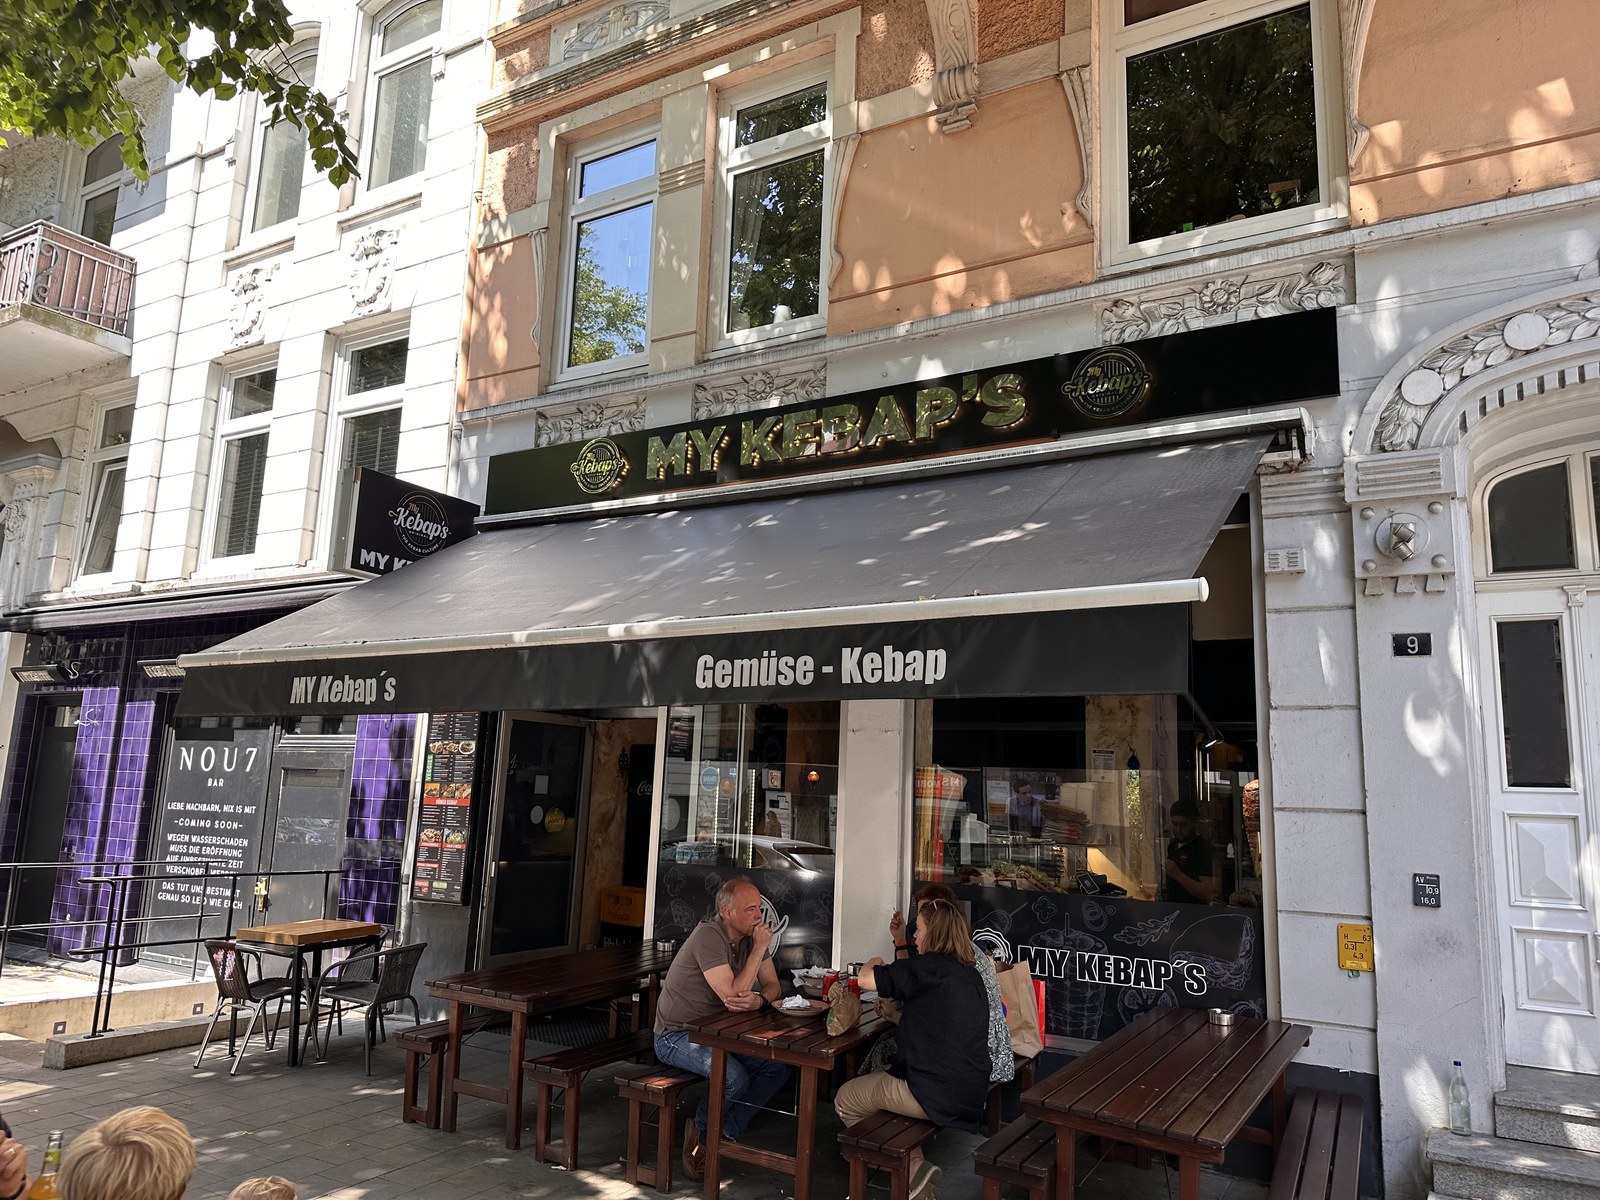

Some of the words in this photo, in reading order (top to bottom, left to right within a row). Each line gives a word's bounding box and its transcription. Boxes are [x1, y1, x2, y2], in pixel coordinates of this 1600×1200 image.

[646, 424, 729, 480] MY
[740, 373, 1027, 466] KEBAP'S
[393, 507, 449, 540] Kebap's
[422, 543, 439, 554] CULTURE
[359, 548, 390, 570] MY
[1406, 636, 1419, 654] 9
[695, 650, 815, 689] Gemüse
[841, 645, 947, 685] Kebap
[289, 675, 317, 704] MY
[179, 746, 258, 772] NOU7
[207, 778, 224, 787] BAR
[167, 802, 185, 810] LIEBE
[186, 803, 221, 813] NACHBARN,
[223, 804, 235, 812] NIX
[235, 805, 242, 813] IS
[244, 806, 256, 814] MIT
[167, 833, 190, 842] WEGEN
[191, 834, 248, 847] WASSERSCHADEN
[169, 844, 187, 852] MUSS
[188, 845, 199, 854] DIE
[201, 846, 242, 857] ERÖFFNUNG
[228, 859, 244, 869] ZEIT
[162, 881, 175, 890] DAS
[177, 883, 189, 892] TUT
[206, 886, 241, 898] BESTIMT
[157, 891, 179, 902] GENAU
[180, 894, 190, 903] SO
[192, 895, 207, 905] LED
[209, 897, 222, 907] WIE
[1362, 934, 1371, 942] 63
[1017, 945, 1070, 979] MY
